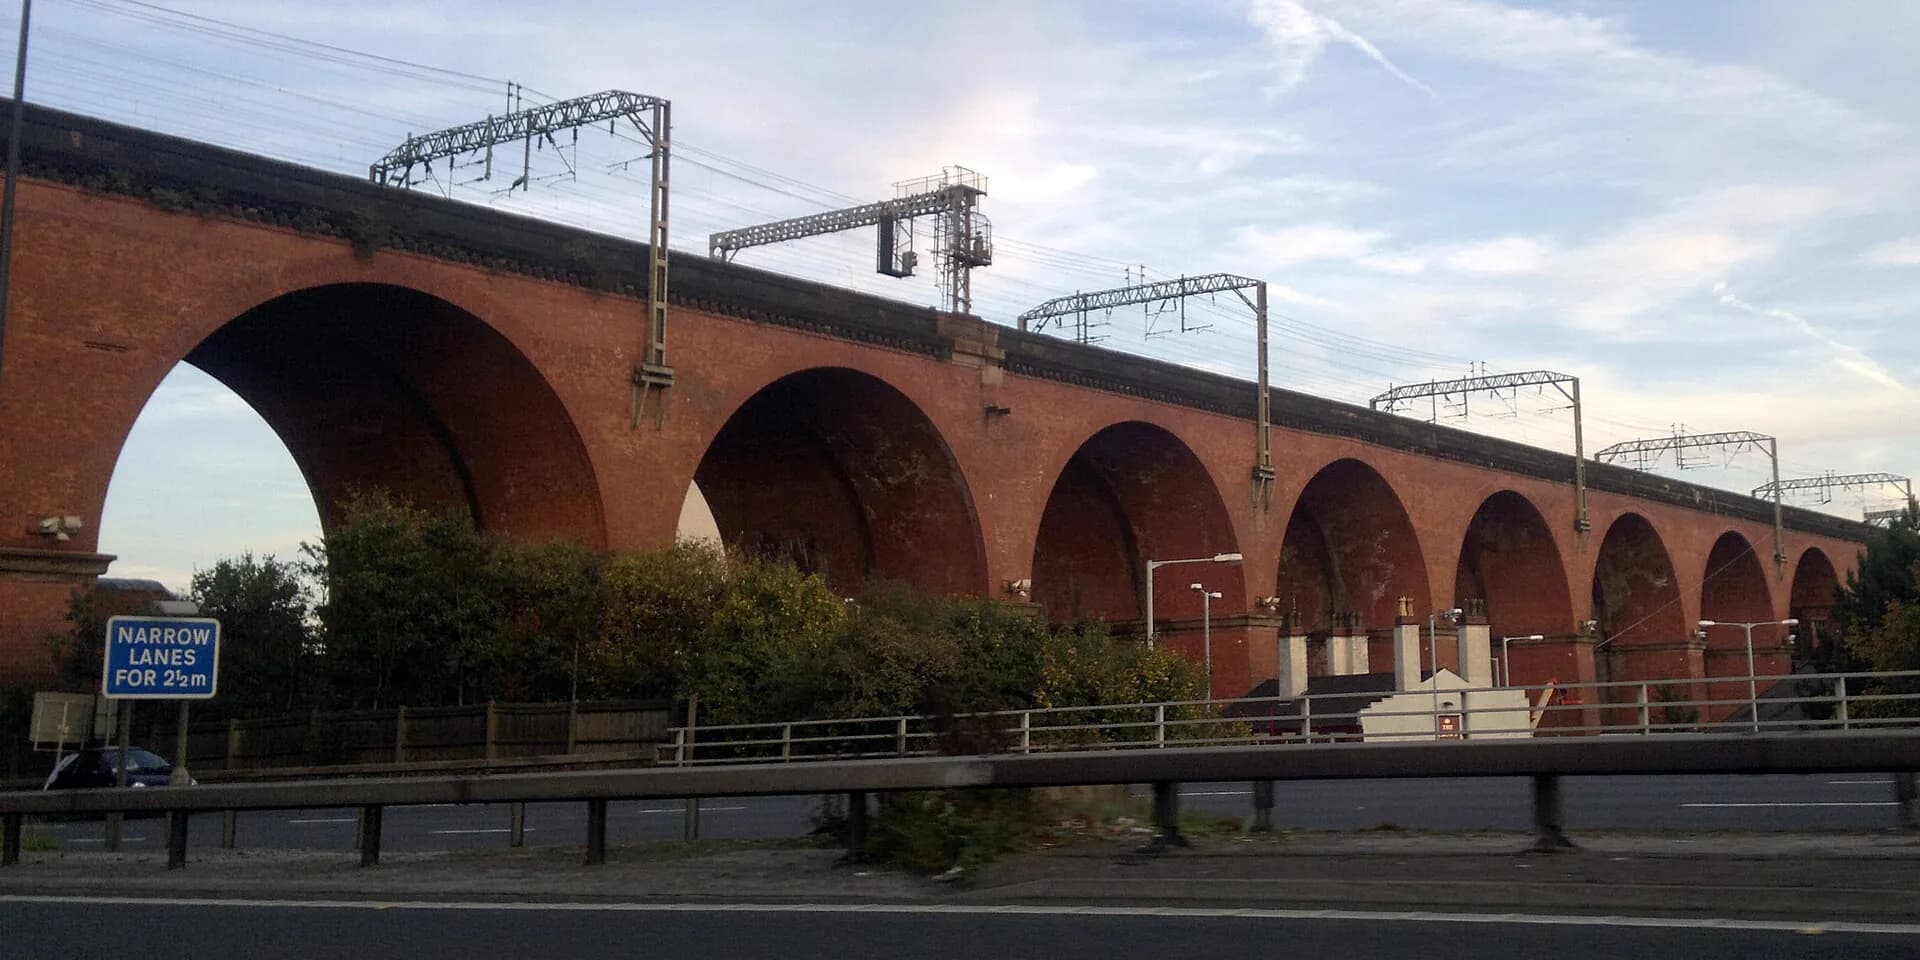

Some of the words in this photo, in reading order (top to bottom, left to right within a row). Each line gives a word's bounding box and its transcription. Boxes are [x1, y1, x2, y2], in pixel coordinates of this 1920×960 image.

[118, 627, 210, 645] NARROW
[130, 649, 196, 666] LANES
[115, 669, 156, 687] FOR
